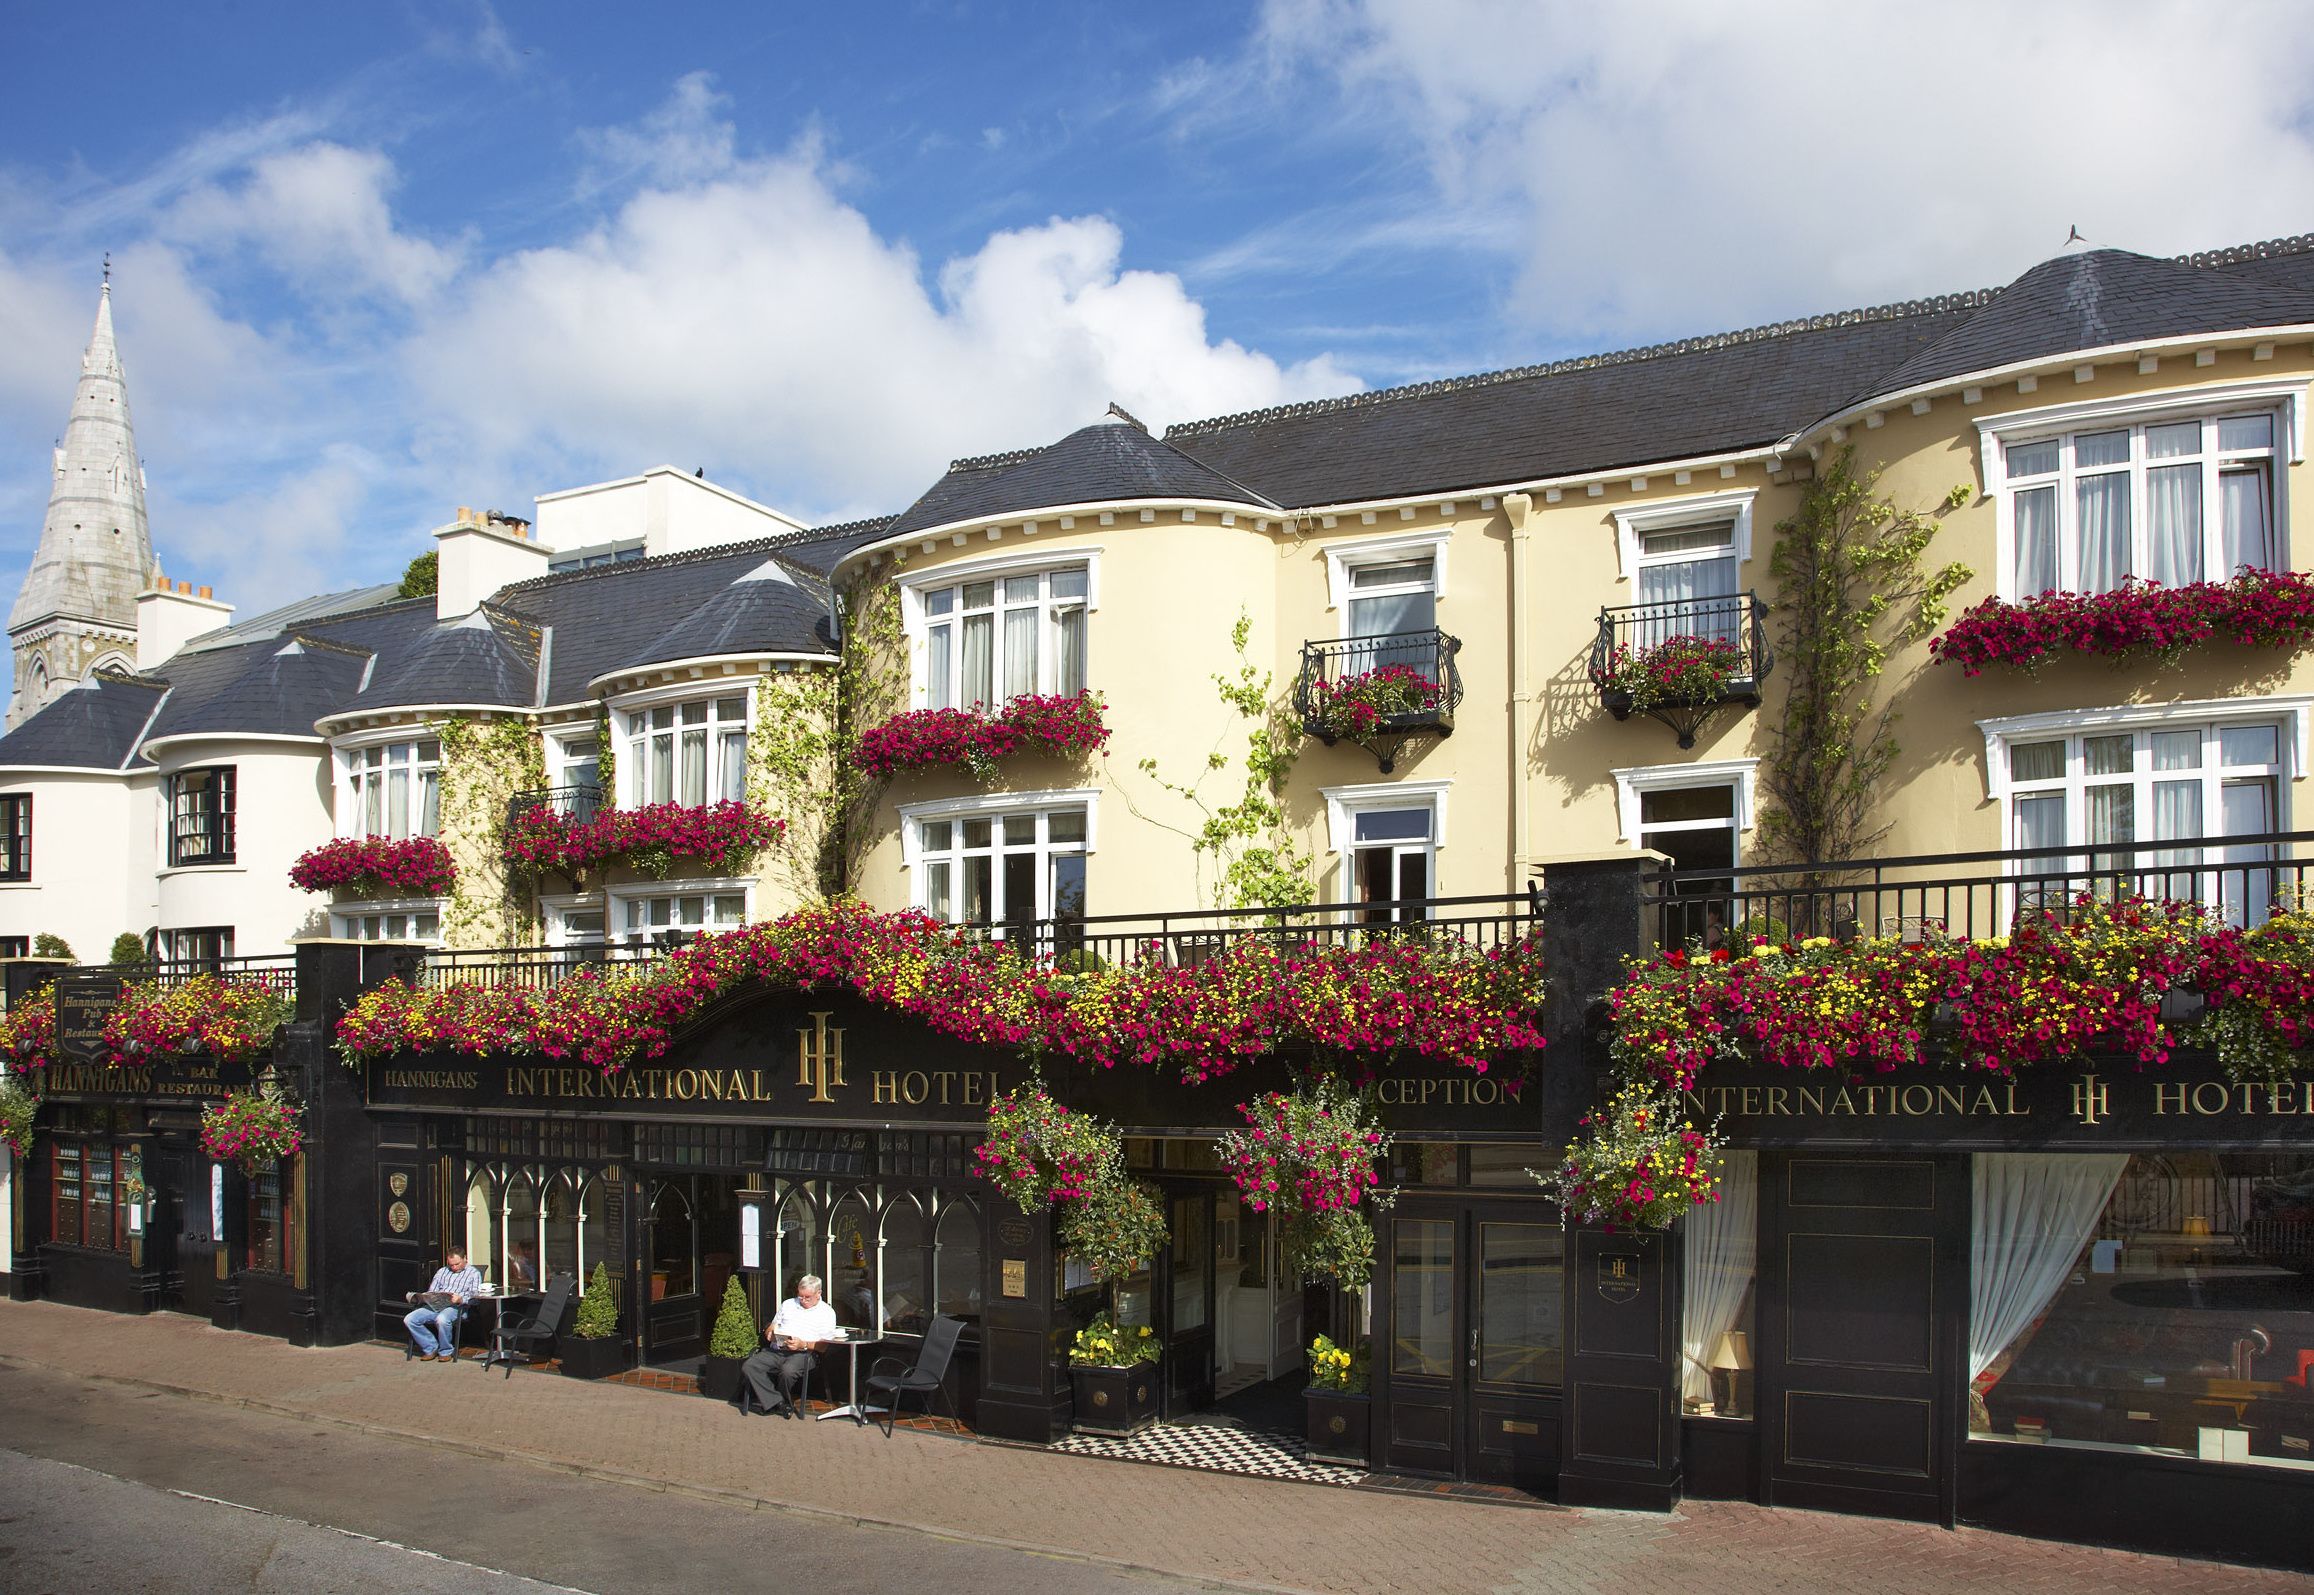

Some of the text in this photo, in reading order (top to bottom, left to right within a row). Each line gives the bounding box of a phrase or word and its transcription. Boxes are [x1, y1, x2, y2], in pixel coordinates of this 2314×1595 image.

[64, 996, 117, 1008] Hannigans
[82, 1008, 102, 1019] Pub
[64, 1028, 101, 1038] Restau
[50, 1065, 151, 1093] HANNIGANS
[384, 1070, 479, 1090] HANNIGANS
[506, 1067, 771, 1101] INTERNATIONAL
[783, 1221, 798, 1229] PEN
